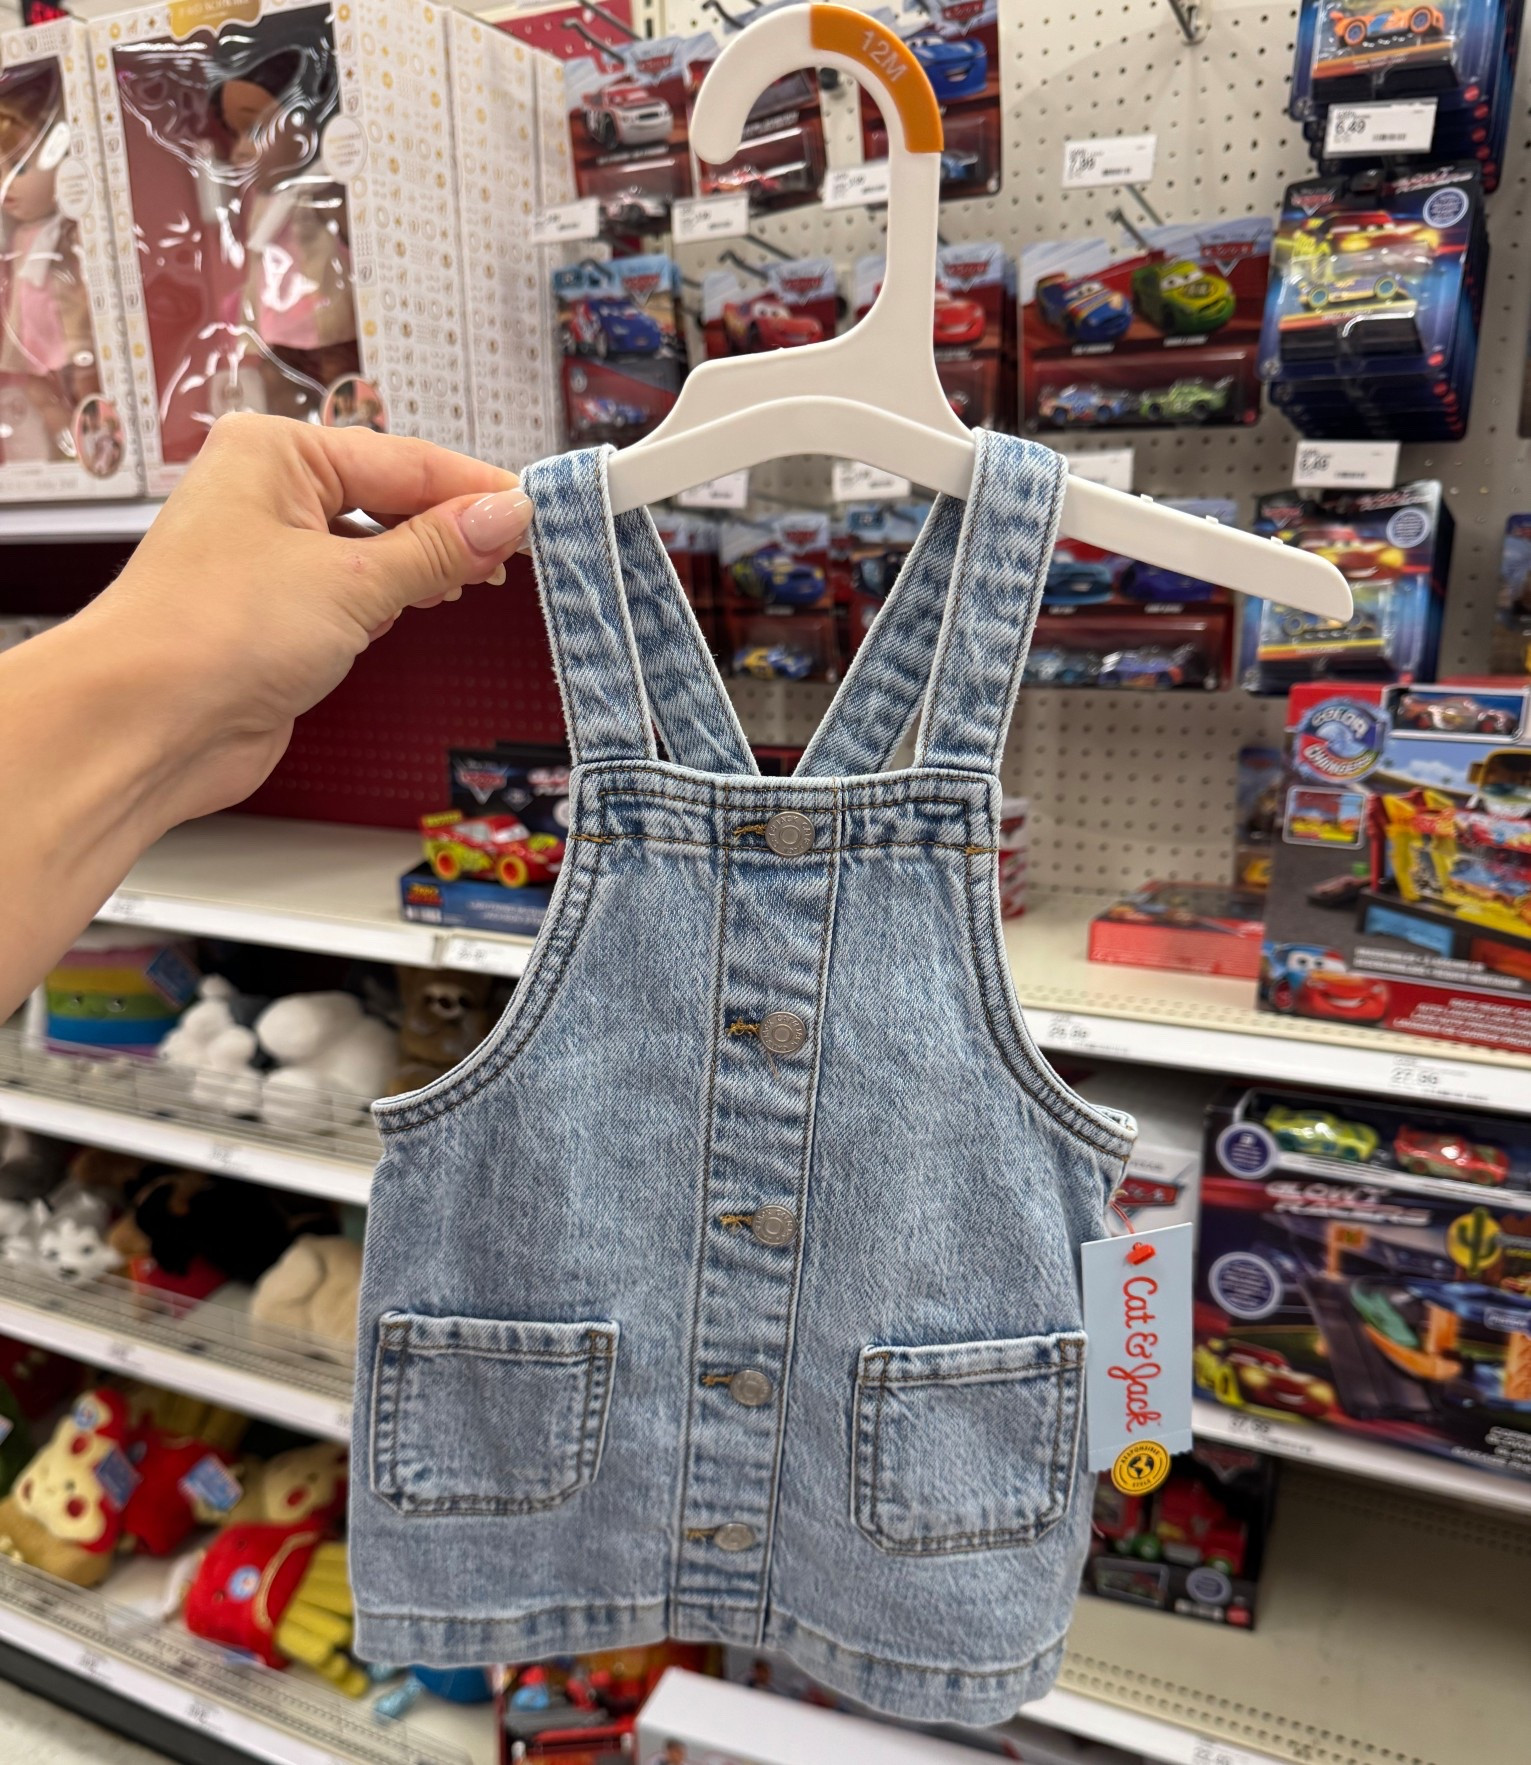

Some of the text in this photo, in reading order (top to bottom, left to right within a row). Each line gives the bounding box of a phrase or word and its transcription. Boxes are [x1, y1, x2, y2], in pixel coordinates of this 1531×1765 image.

[862, 30, 908, 82] 12M
[1107, 1276, 1162, 1433] Cat & Jack
[1120, 1446, 1160, 1464] RESPONSIBLE
